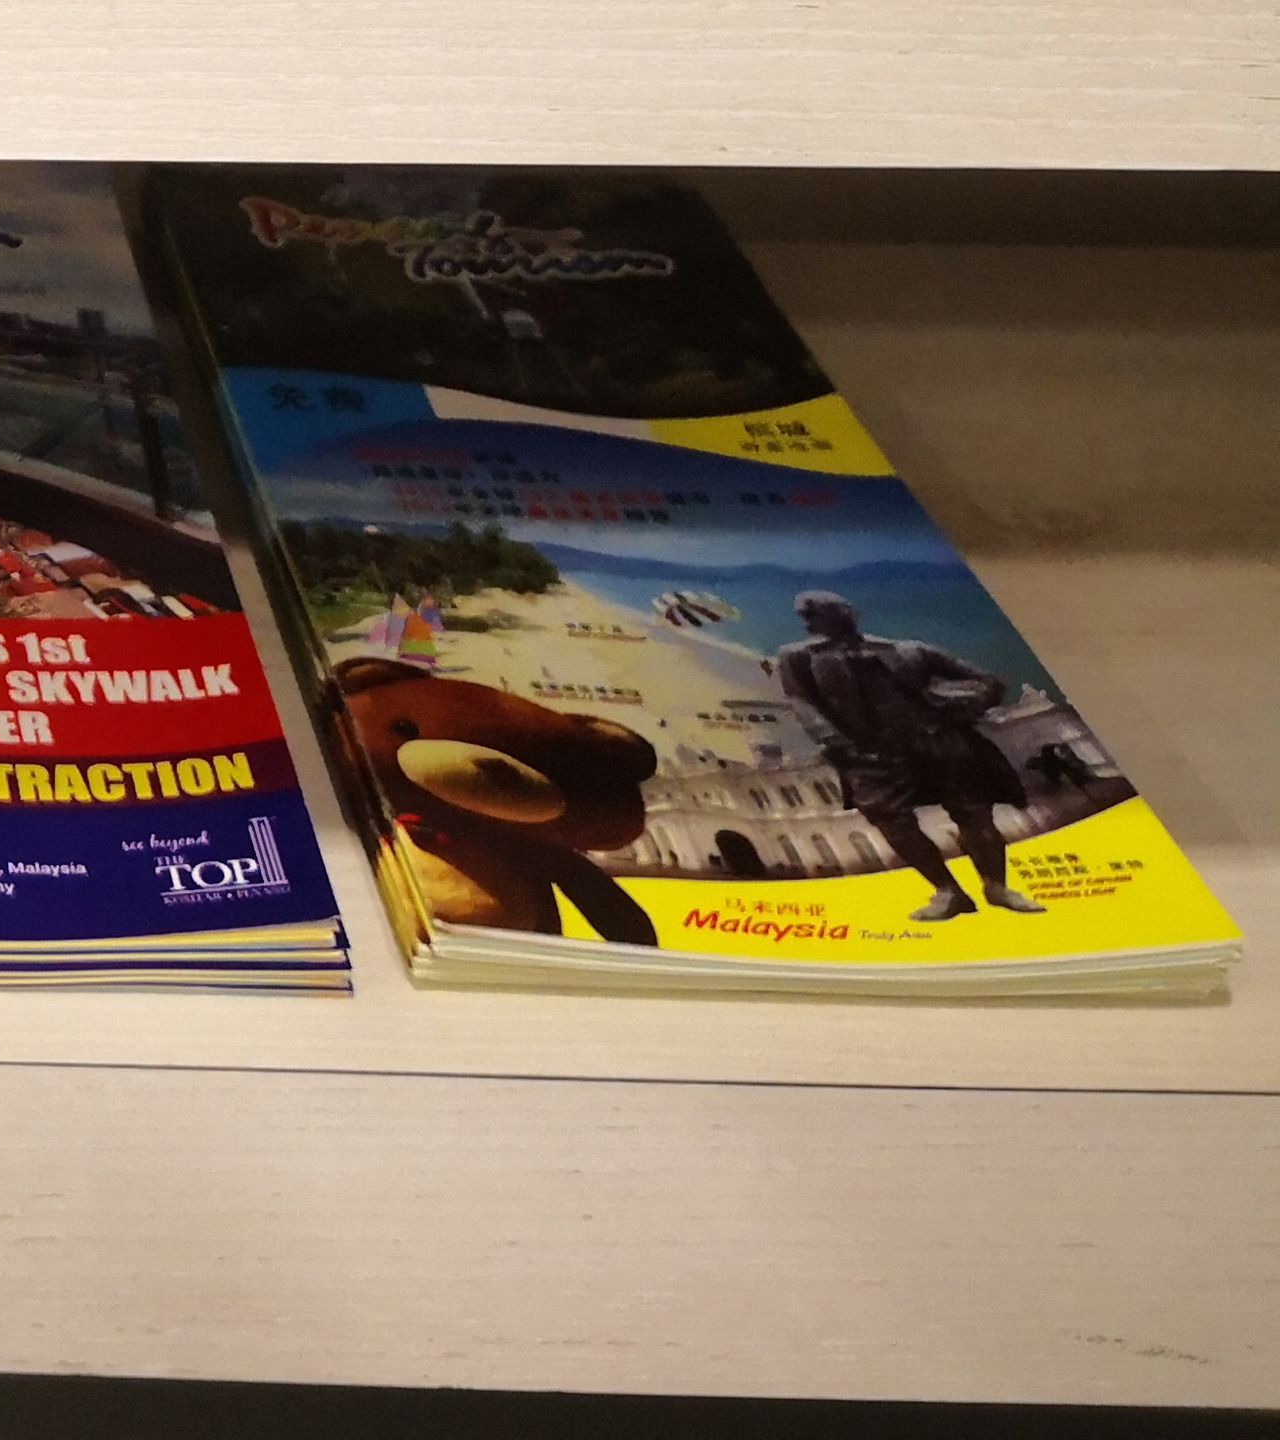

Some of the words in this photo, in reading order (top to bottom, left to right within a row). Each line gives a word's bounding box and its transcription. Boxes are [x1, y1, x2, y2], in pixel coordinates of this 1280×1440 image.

[17, 631, 92, 666] 1st
[6, 663, 240, 706] SKYWALK
[8, 861, 88, 879] Malaysia
[154, 857, 259, 892] TOP
[683, 908, 850, 944] Malaysia
